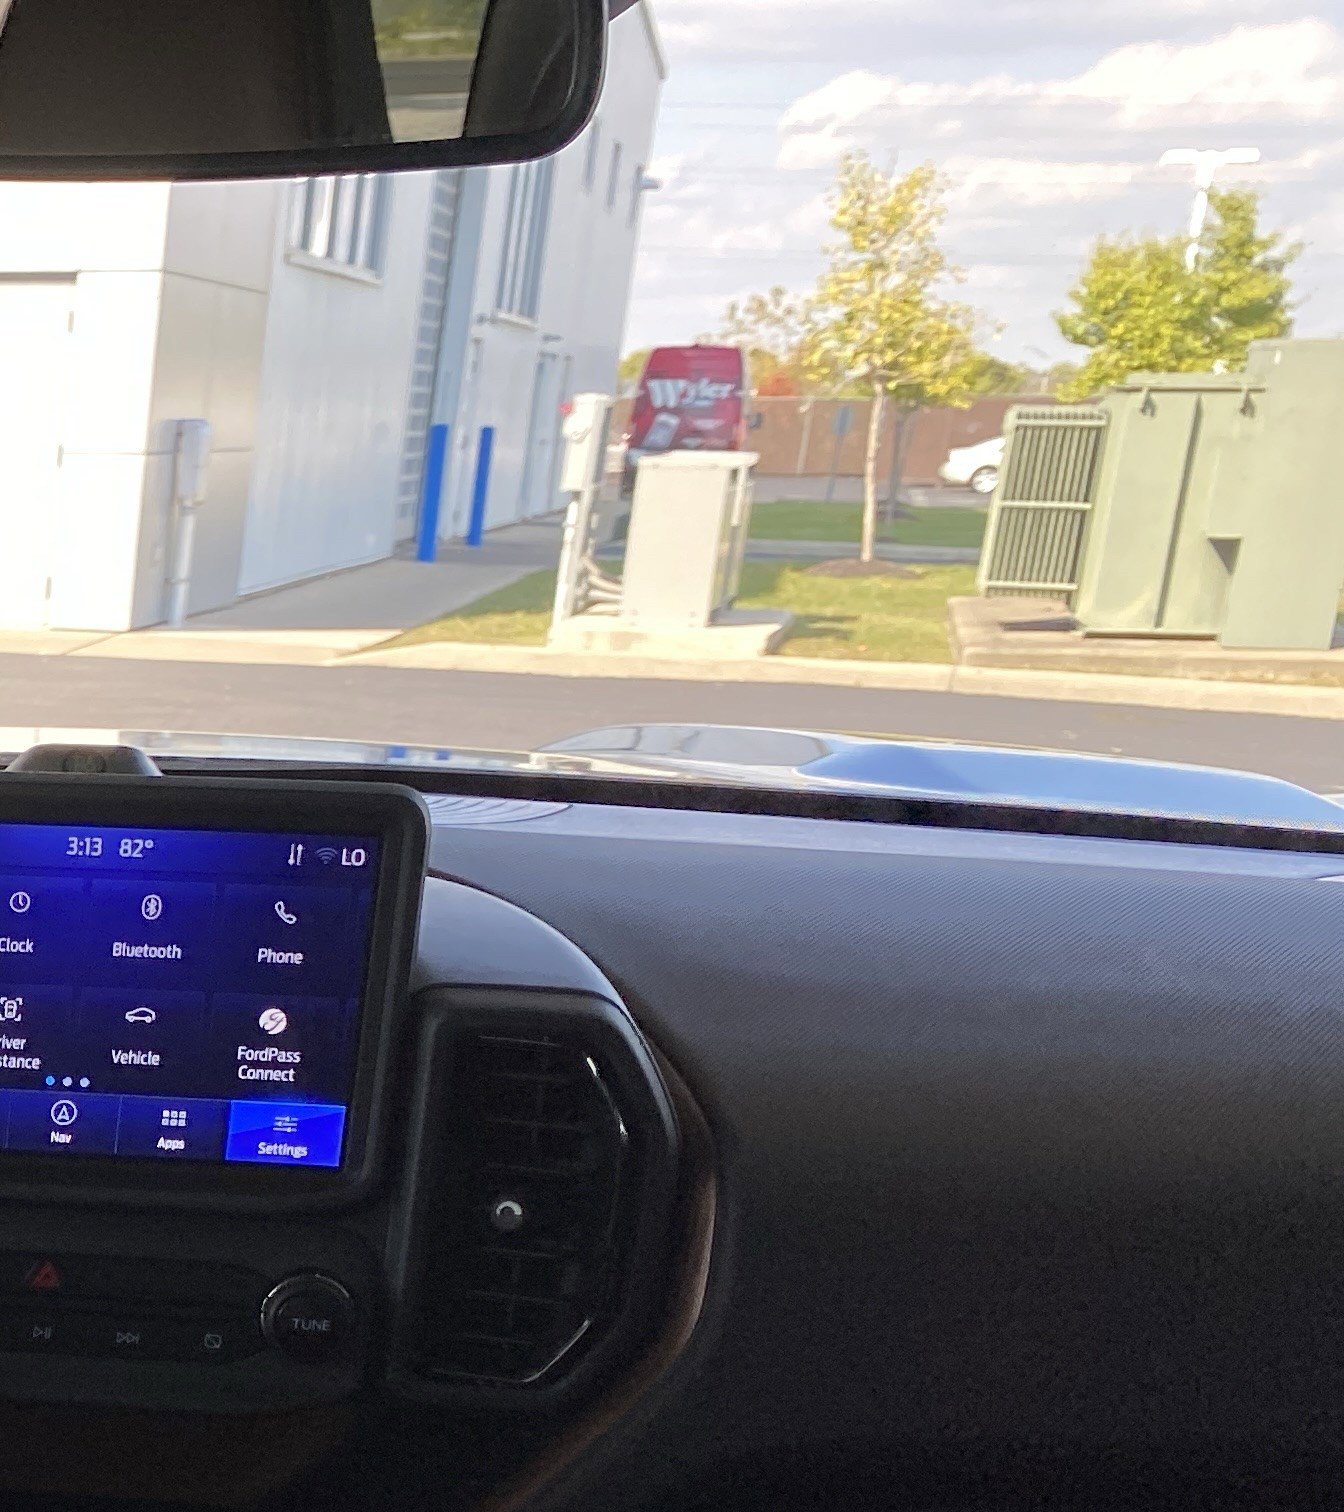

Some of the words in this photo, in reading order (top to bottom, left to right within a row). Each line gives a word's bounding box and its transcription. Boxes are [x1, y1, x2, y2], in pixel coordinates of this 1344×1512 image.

[66, 836, 103, 857] 3:13
[119, 838, 154, 858] 82°
[341, 848, 366, 866] LO
[112, 941, 182, 959] Bluetooth
[257, 947, 304, 965] Phone
[111, 1049, 161, 1066] Vehicle
[237, 1045, 301, 1064] FordPass
[237, 1065, 296, 1082] Connect
[50, 1130, 72, 1144] Nav
[156, 1136, 185, 1151] Apps
[257, 1141, 308, 1159] Settings
[291, 1317, 331, 1331] TUNE
